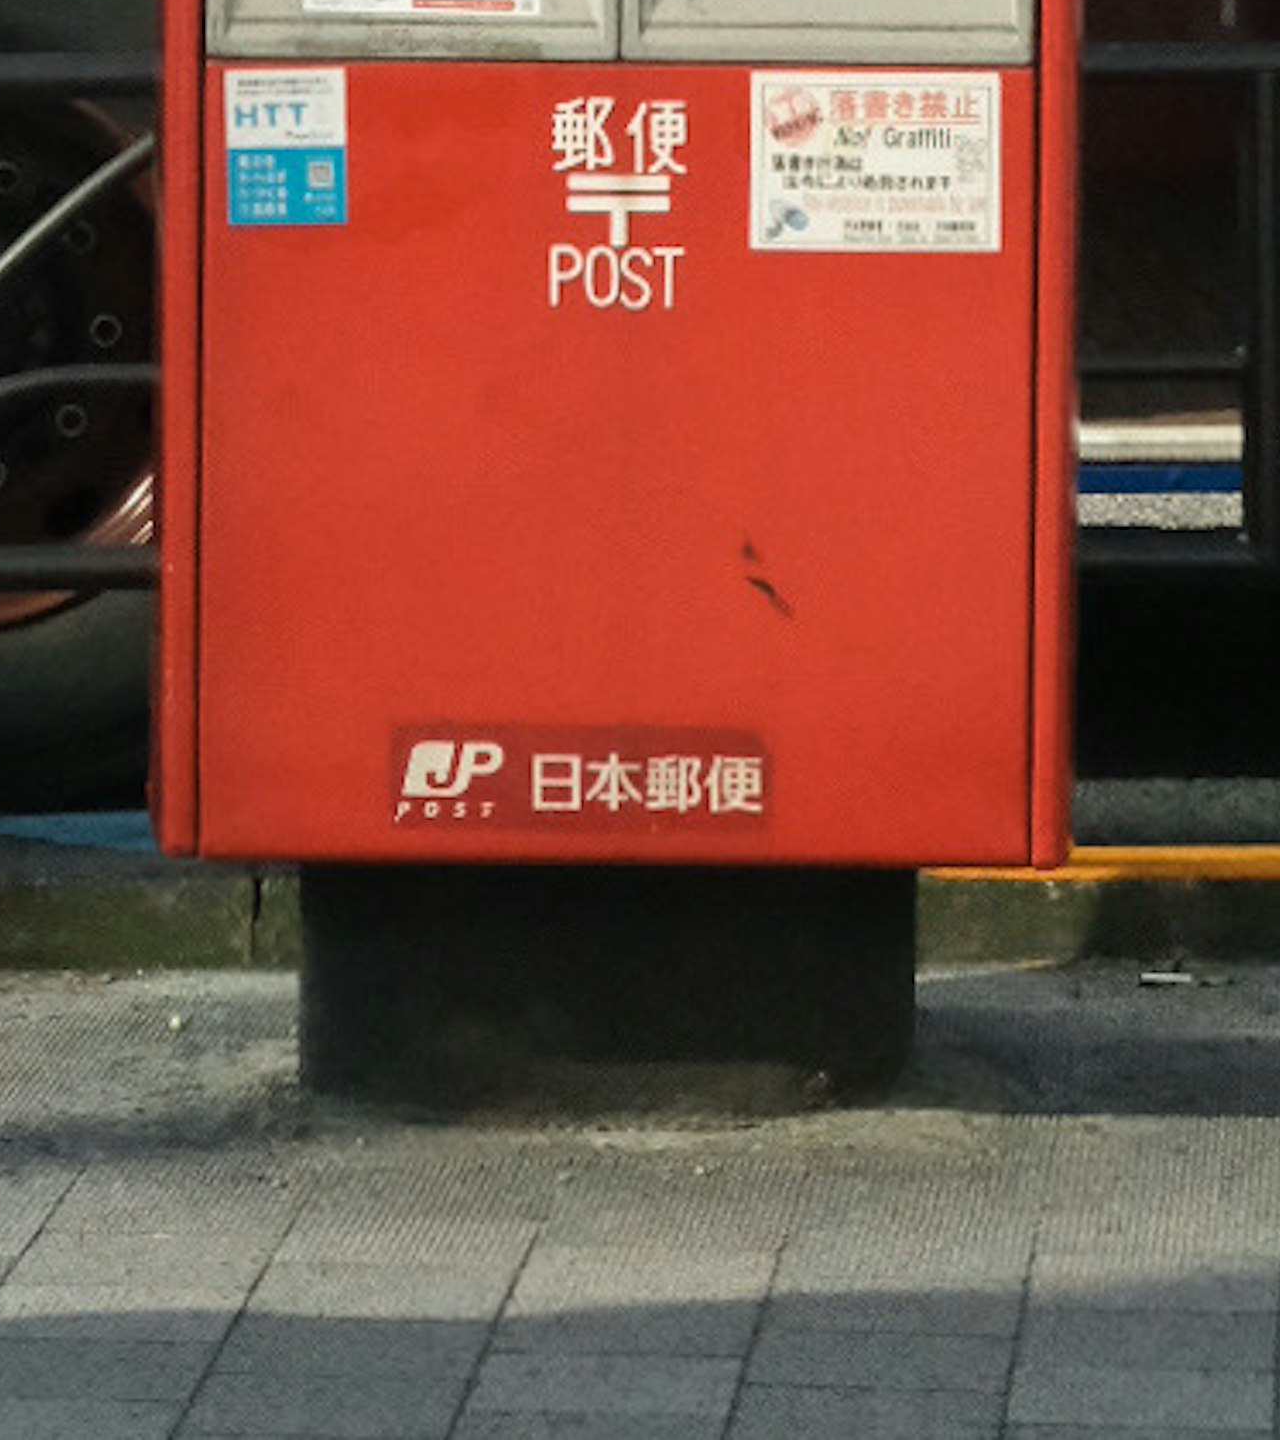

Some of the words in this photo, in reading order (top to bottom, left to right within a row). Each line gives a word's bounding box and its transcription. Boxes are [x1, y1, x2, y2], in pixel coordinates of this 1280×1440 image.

[234, 103, 309, 128] HTT
[551, 95, 688, 175] 郵便
[883, 128, 952, 150] Graffiti
[548, 242, 686, 310] POST
[402, 740, 504, 797] JP
[531, 751, 764, 813] 日本郵便
[394, 801, 496, 822] POST
